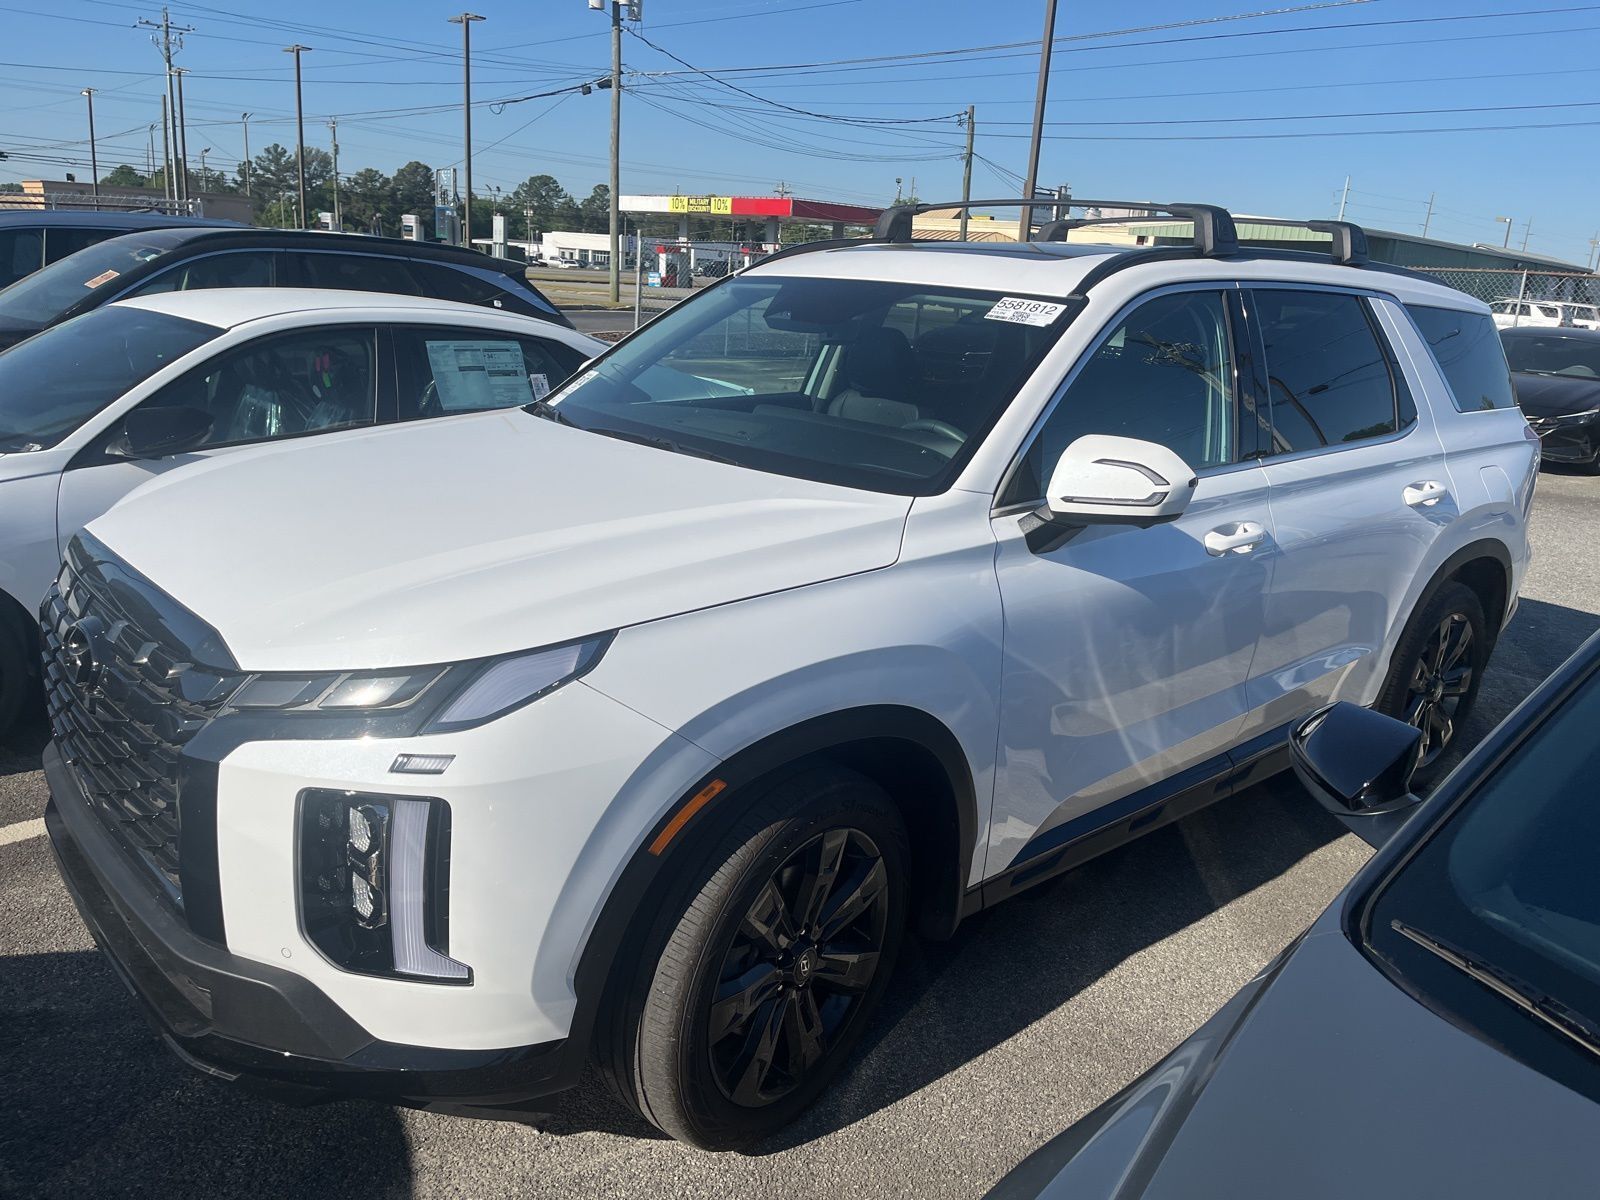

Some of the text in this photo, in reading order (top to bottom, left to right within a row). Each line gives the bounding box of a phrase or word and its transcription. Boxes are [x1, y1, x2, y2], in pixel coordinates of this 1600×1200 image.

[672, 197, 685, 209] 10%
[713, 198, 728, 210] 10%
[997, 299, 1058, 315] 5581812
